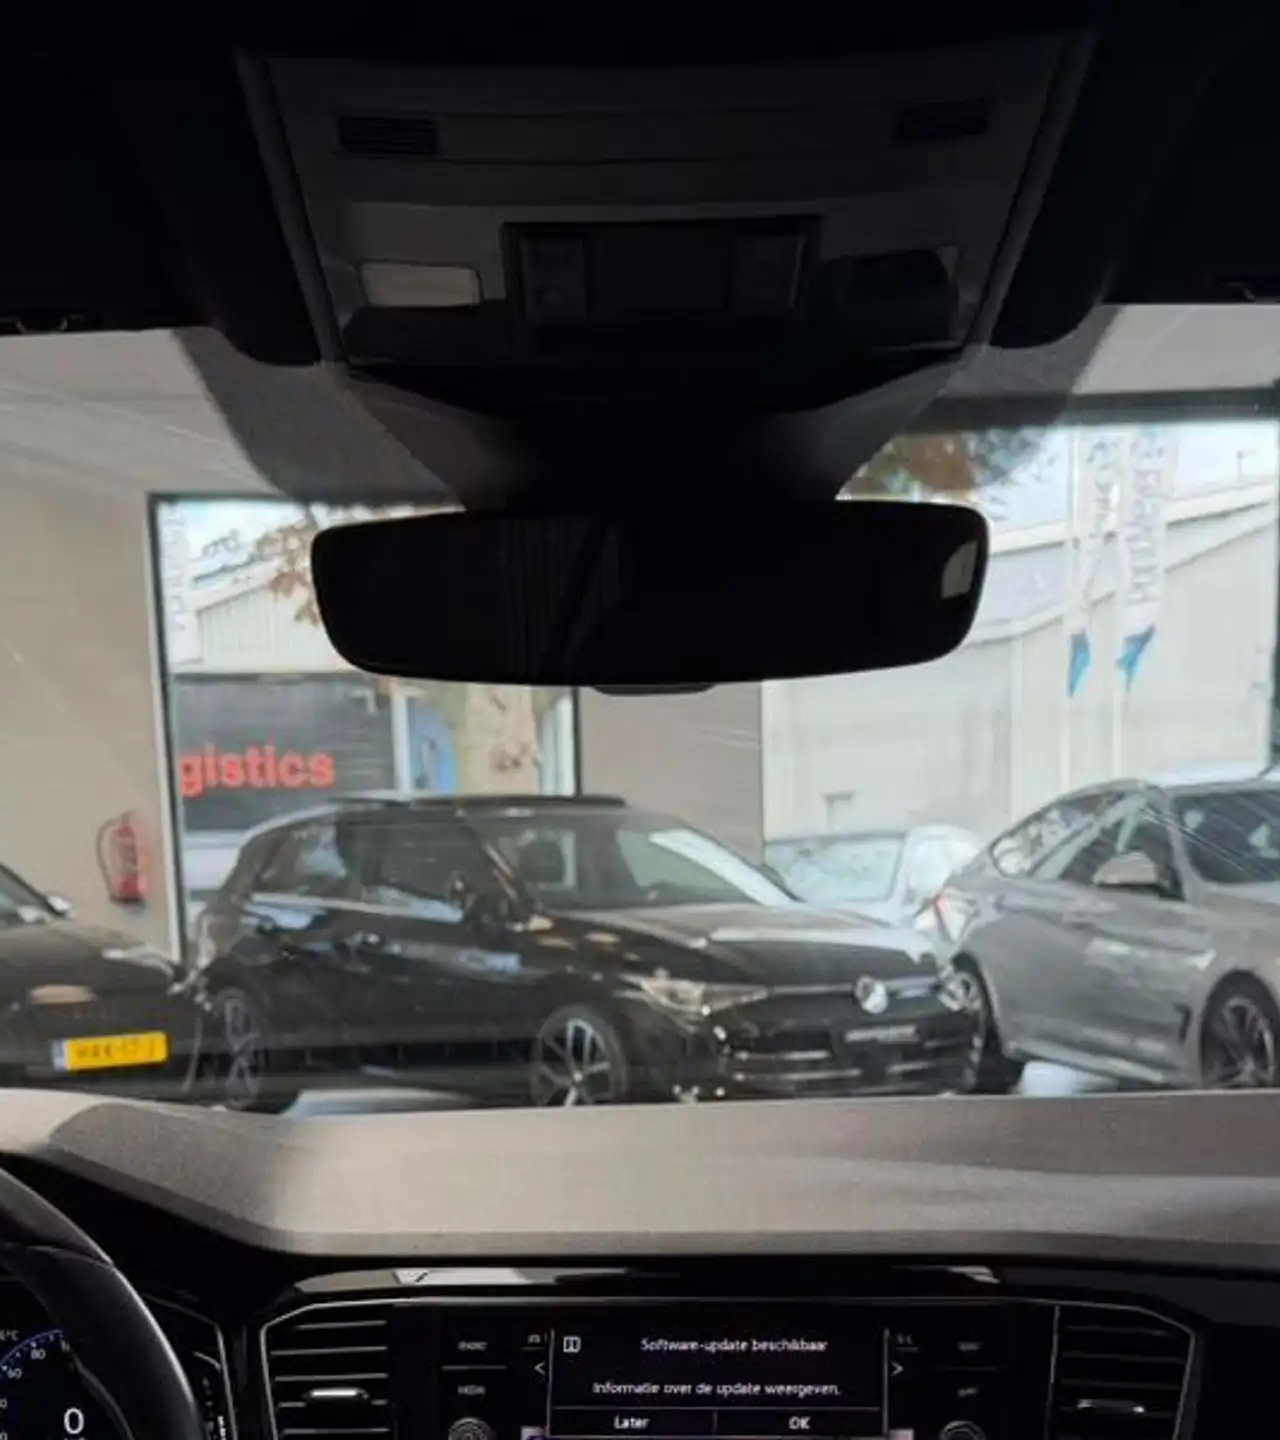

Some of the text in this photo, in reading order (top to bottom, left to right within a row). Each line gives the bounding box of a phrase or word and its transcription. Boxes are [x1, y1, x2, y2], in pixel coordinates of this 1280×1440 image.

[180, 743, 334, 797] gistics
[640, 1338, 828, 1354] Software-update beschikbaar
[592, 1381, 660, 1395] Informatie
[663, 1384, 692, 1395] over
[695, 1382, 713, 1395] de
[716, 1382, 762, 1398] update
[63, 1407, 85, 1435] 0
[613, 1414, 650, 1430] Later
[788, 1416, 811, 1430] OK
